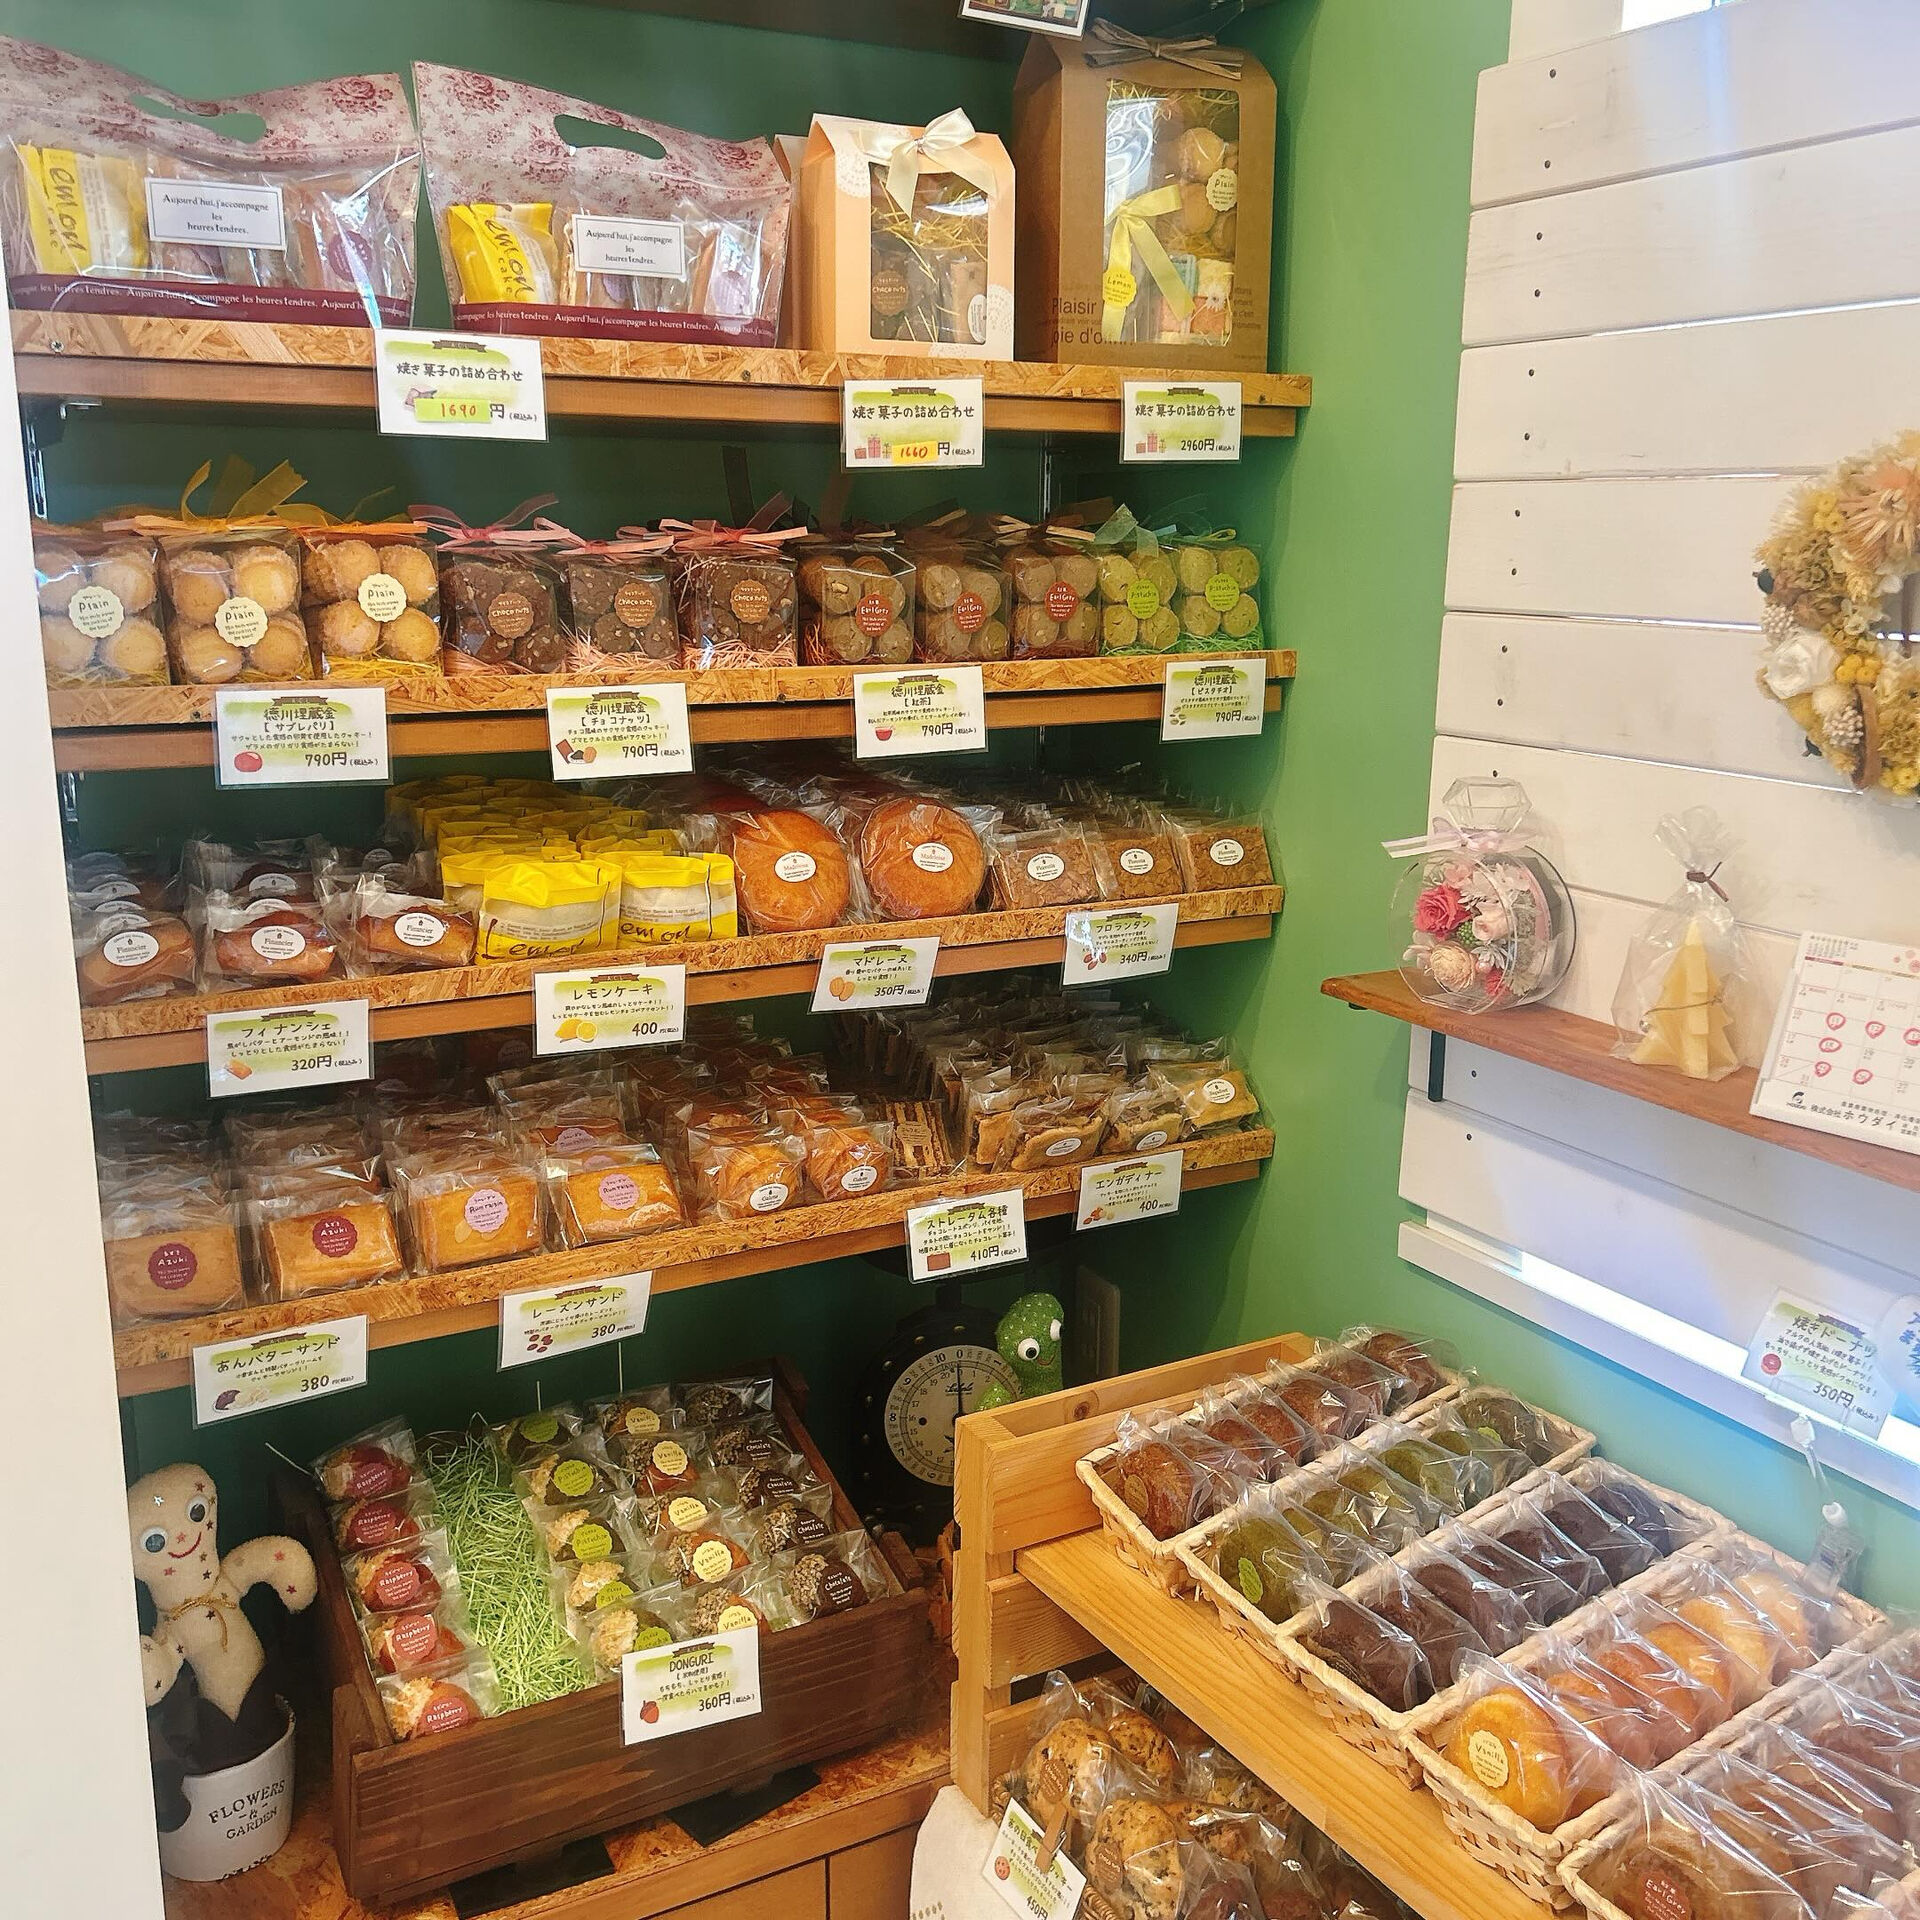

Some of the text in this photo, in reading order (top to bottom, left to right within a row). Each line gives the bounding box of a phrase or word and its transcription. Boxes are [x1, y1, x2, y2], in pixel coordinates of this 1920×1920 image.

[211, 212, 223, 222] les
[187, 222, 250, 235] heures tendres.
[604, 253, 631, 263] heures
[624, 245, 636, 254] les
[498, 257, 514, 296] cake
[242, 294, 254, 303] les
[255, 295, 283, 306] heures
[283, 296, 318, 309] tendres.
[1051, 297, 1097, 316] Plaisir
[486, 311, 496, 320] les
[496, 312, 521, 322] heures
[521, 312, 553, 323] tendres.
[648, 318, 659, 328] les
[659, 319, 684, 330] heures
[396, 361, 524, 384] 焼き菓子の詰め合わせ
[852, 404, 975, 422] 焼き菓子の詰め合わせ
[1135, 403, 1236, 419] 焼き菓子の詰め合わせ
[368, 589, 395, 602] Plain
[79, 600, 109, 613] Plain
[225, 609, 255, 623] Plain
[1194, 673, 1240, 687] 徳川埋蔵金
[890, 683, 947, 698] 徳川埋蔵金
[264, 706, 338, 725] 徳川埋蔵金
[585, 700, 648, 718] 徳川埋蔵金
[1215, 709, 1243, 723] 790円
[921, 722, 954, 737] 790円
[304, 751, 348, 771] 790円
[622, 743, 659, 761] 790円
[1096, 920, 1151, 934] フロランタン
[852, 953, 908, 970] マドレーヌ
[1119, 951, 1149, 965] 340円
[572, 983, 654, 1002] レモンケーキ
[874, 984, 905, 998] 350円
[241, 1021, 333, 1040] フィナンシェ
[631, 1021, 659, 1038] 400
[291, 1054, 333, 1073] 320円
[1095, 1170, 1163, 1191] エンガディナー
[1138, 1199, 1160, 1214] 400
[927, 1204, 1010, 1231] ストレータム各種
[320, 1227, 349, 1238] Azuki
[158, 1256, 189, 1268] Azuki
[970, 1244, 1000, 1264] 410円
[532, 1291, 630, 1320] レーズンサンド
[591, 1322, 616, 1340] 380
[1792, 1315, 1885, 1359] 焼きドーナツ
[216, 1336, 347, 1374] あんバターサンド
[934, 1352, 947, 1364] 10
[300, 1374, 330, 1395] 380
[1812, 1381, 1854, 1409] 350円
[888, 1412, 897, 1425] 8
[673, 1501, 700, 1517] Vanilla
[697, 1549, 726, 1567] Vanilla
[379, 1570, 414, 1587] Raspberry
[395, 1623, 432, 1643] Raspberry
[669, 1652, 715, 1676] DONGURI
[698, 1691, 732, 1715] 360円
[426, 1706, 463, 1725] Raspberry
[1475, 1743, 1504, 1765] Vanilla
[208, 1780, 286, 1824] FLOWERS
[226, 1806, 278, 1840] GARDEN
[1646, 1879, 1687, 1915] Earl Grey
